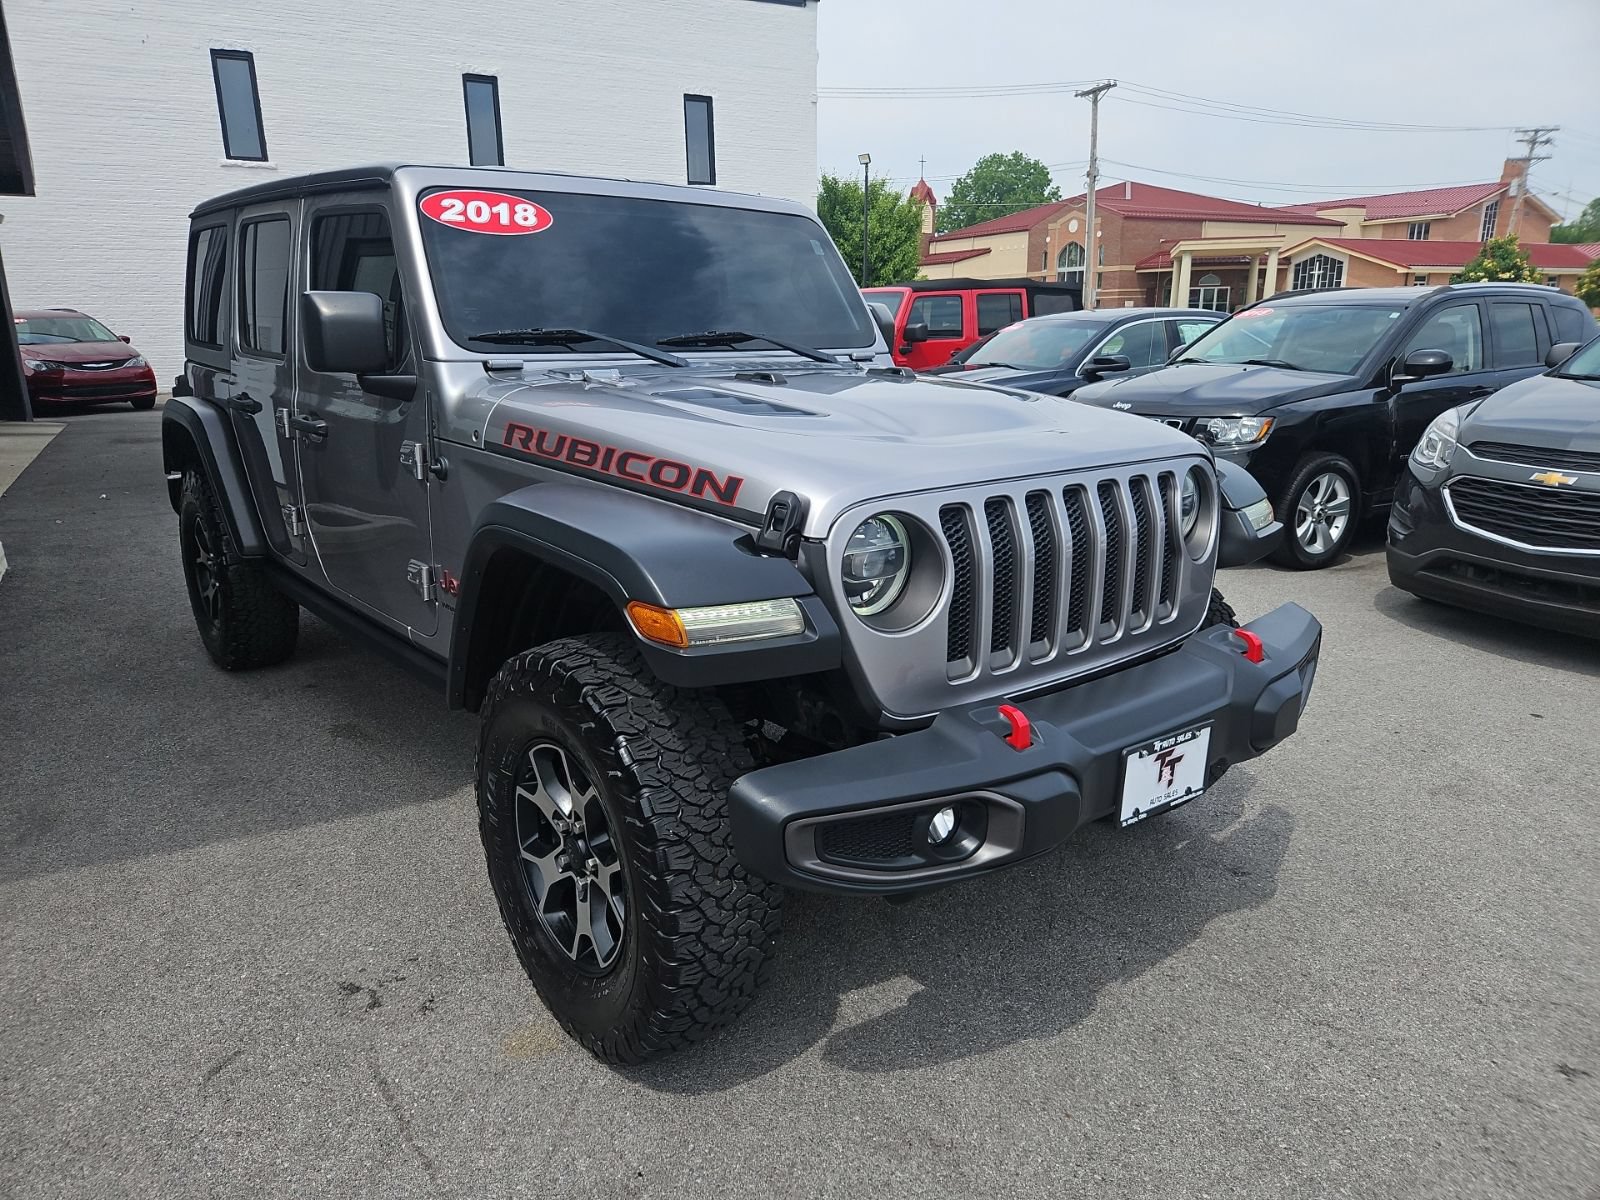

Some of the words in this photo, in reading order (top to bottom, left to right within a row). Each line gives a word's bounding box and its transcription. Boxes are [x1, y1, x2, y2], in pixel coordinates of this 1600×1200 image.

[440, 198, 538, 227] 2018
[1112, 401, 1132, 411] Jeep
[502, 422, 745, 506] RUBICON
[1150, 796, 1162, 805] AUTO
[1164, 789, 1178, 800] SALES
